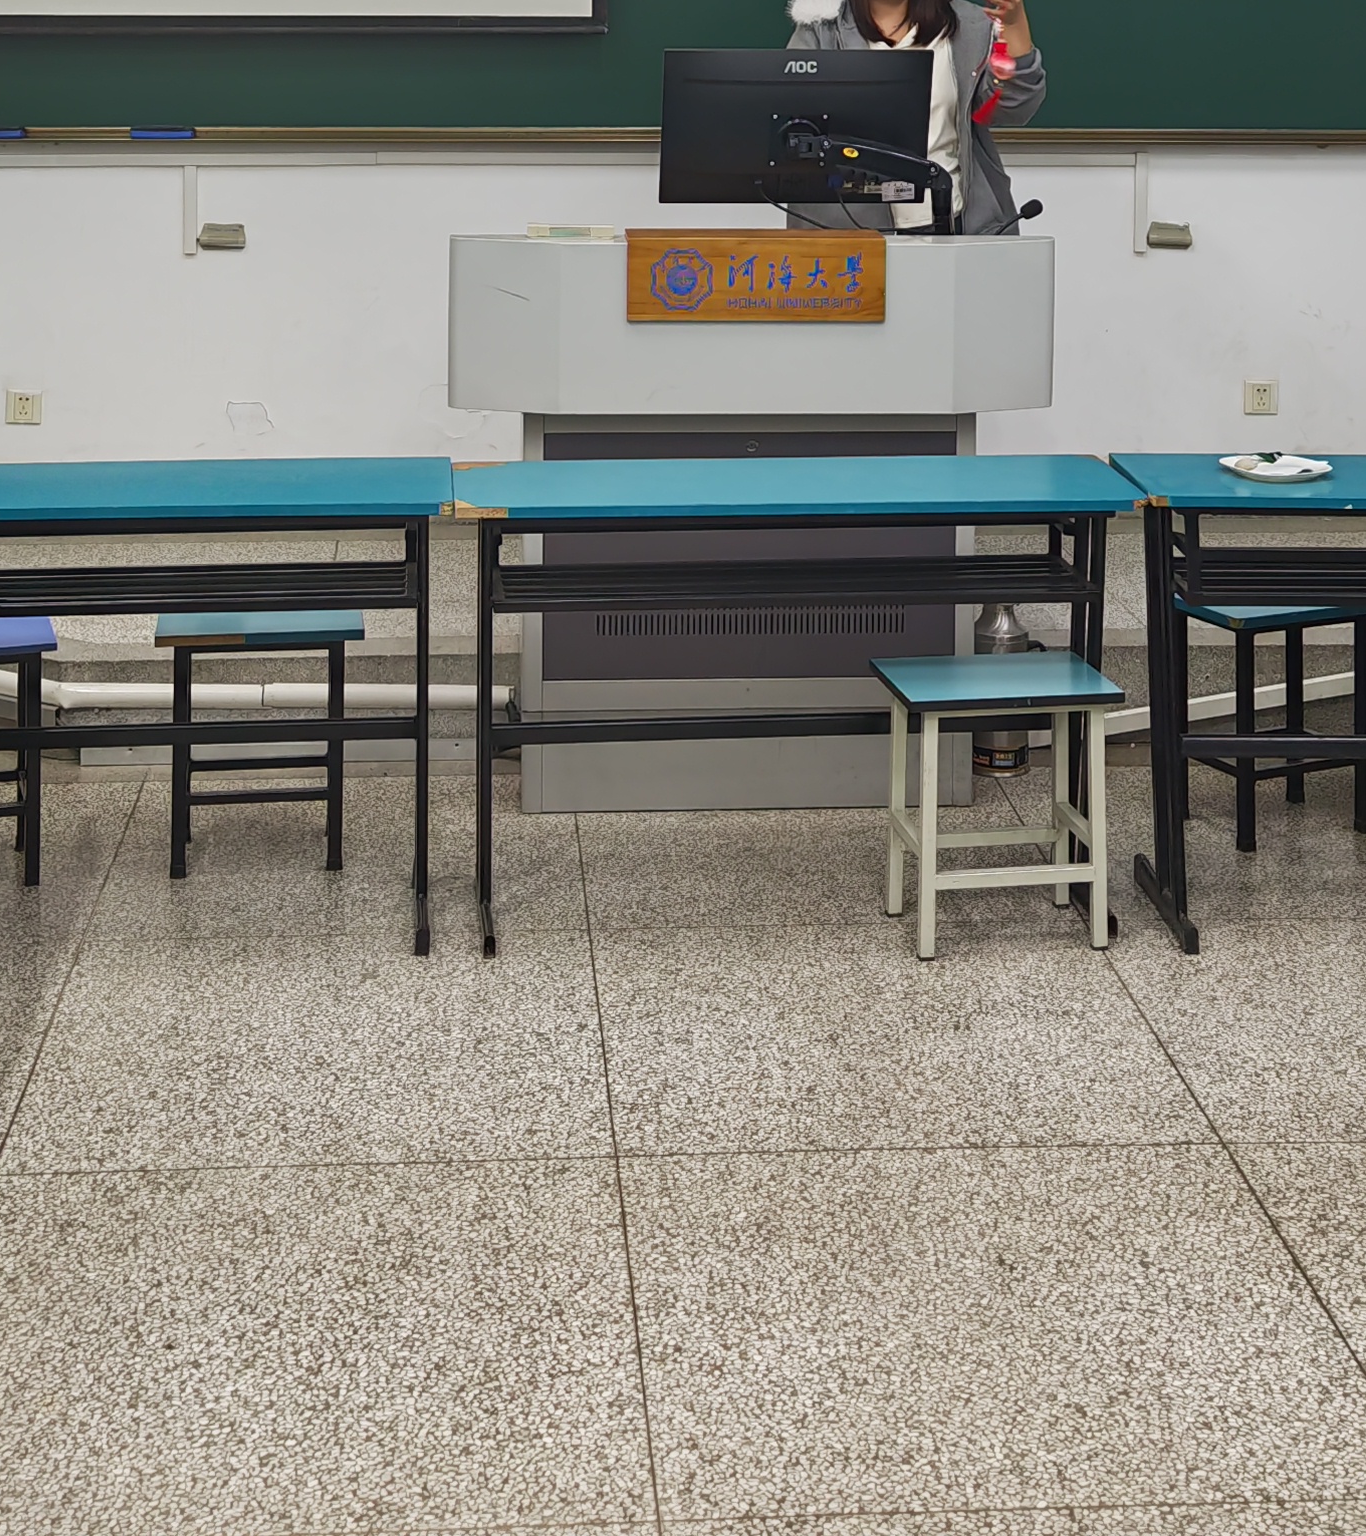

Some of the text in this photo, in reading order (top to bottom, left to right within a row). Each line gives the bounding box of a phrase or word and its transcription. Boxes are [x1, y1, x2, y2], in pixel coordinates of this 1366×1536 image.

[784, 61, 818, 74] AOC
[728, 297, 862, 309] HOHAI UNIVERSITY
